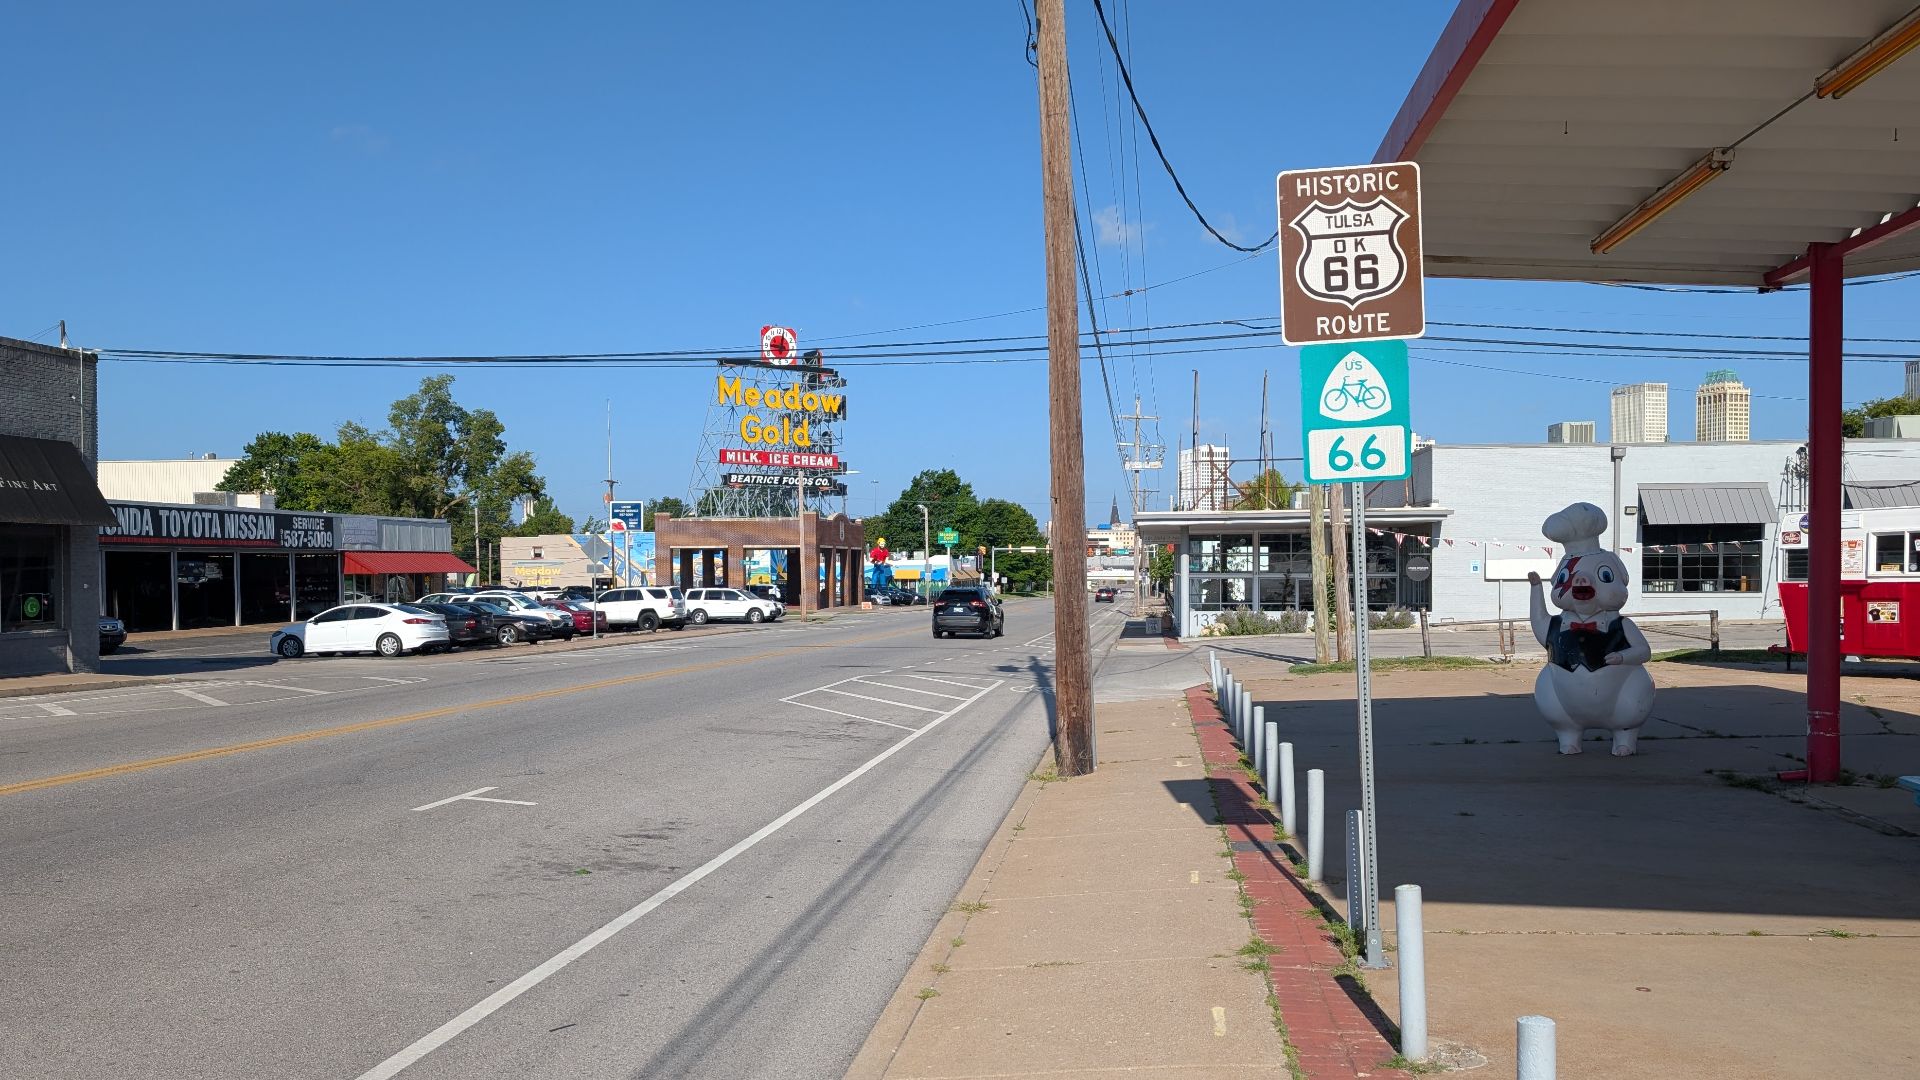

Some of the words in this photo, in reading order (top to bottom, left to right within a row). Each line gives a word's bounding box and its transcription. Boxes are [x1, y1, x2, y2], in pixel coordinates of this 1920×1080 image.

[1296, 170, 1400, 197] HISTORIC
[1324, 212, 1374, 230] TULSA
[1323, 253, 1380, 293] 66
[1316, 312, 1391, 336] ROUTE
[1345, 360, 1363, 371] US
[717, 374, 842, 414] Meadow
[740, 413, 811, 447] Gold
[769, 453, 789, 465] ICE
[793, 455, 833, 467] CREAM
[1328, 433, 1387, 472] 66
[730, 474, 780, 485] BEATRICE
[159, 509, 222, 539] TOYOTA
[224, 513, 275, 540] NISSAN
[292, 516, 325, 530] SERVICE
[284, 530, 333, 548] 587-5009
